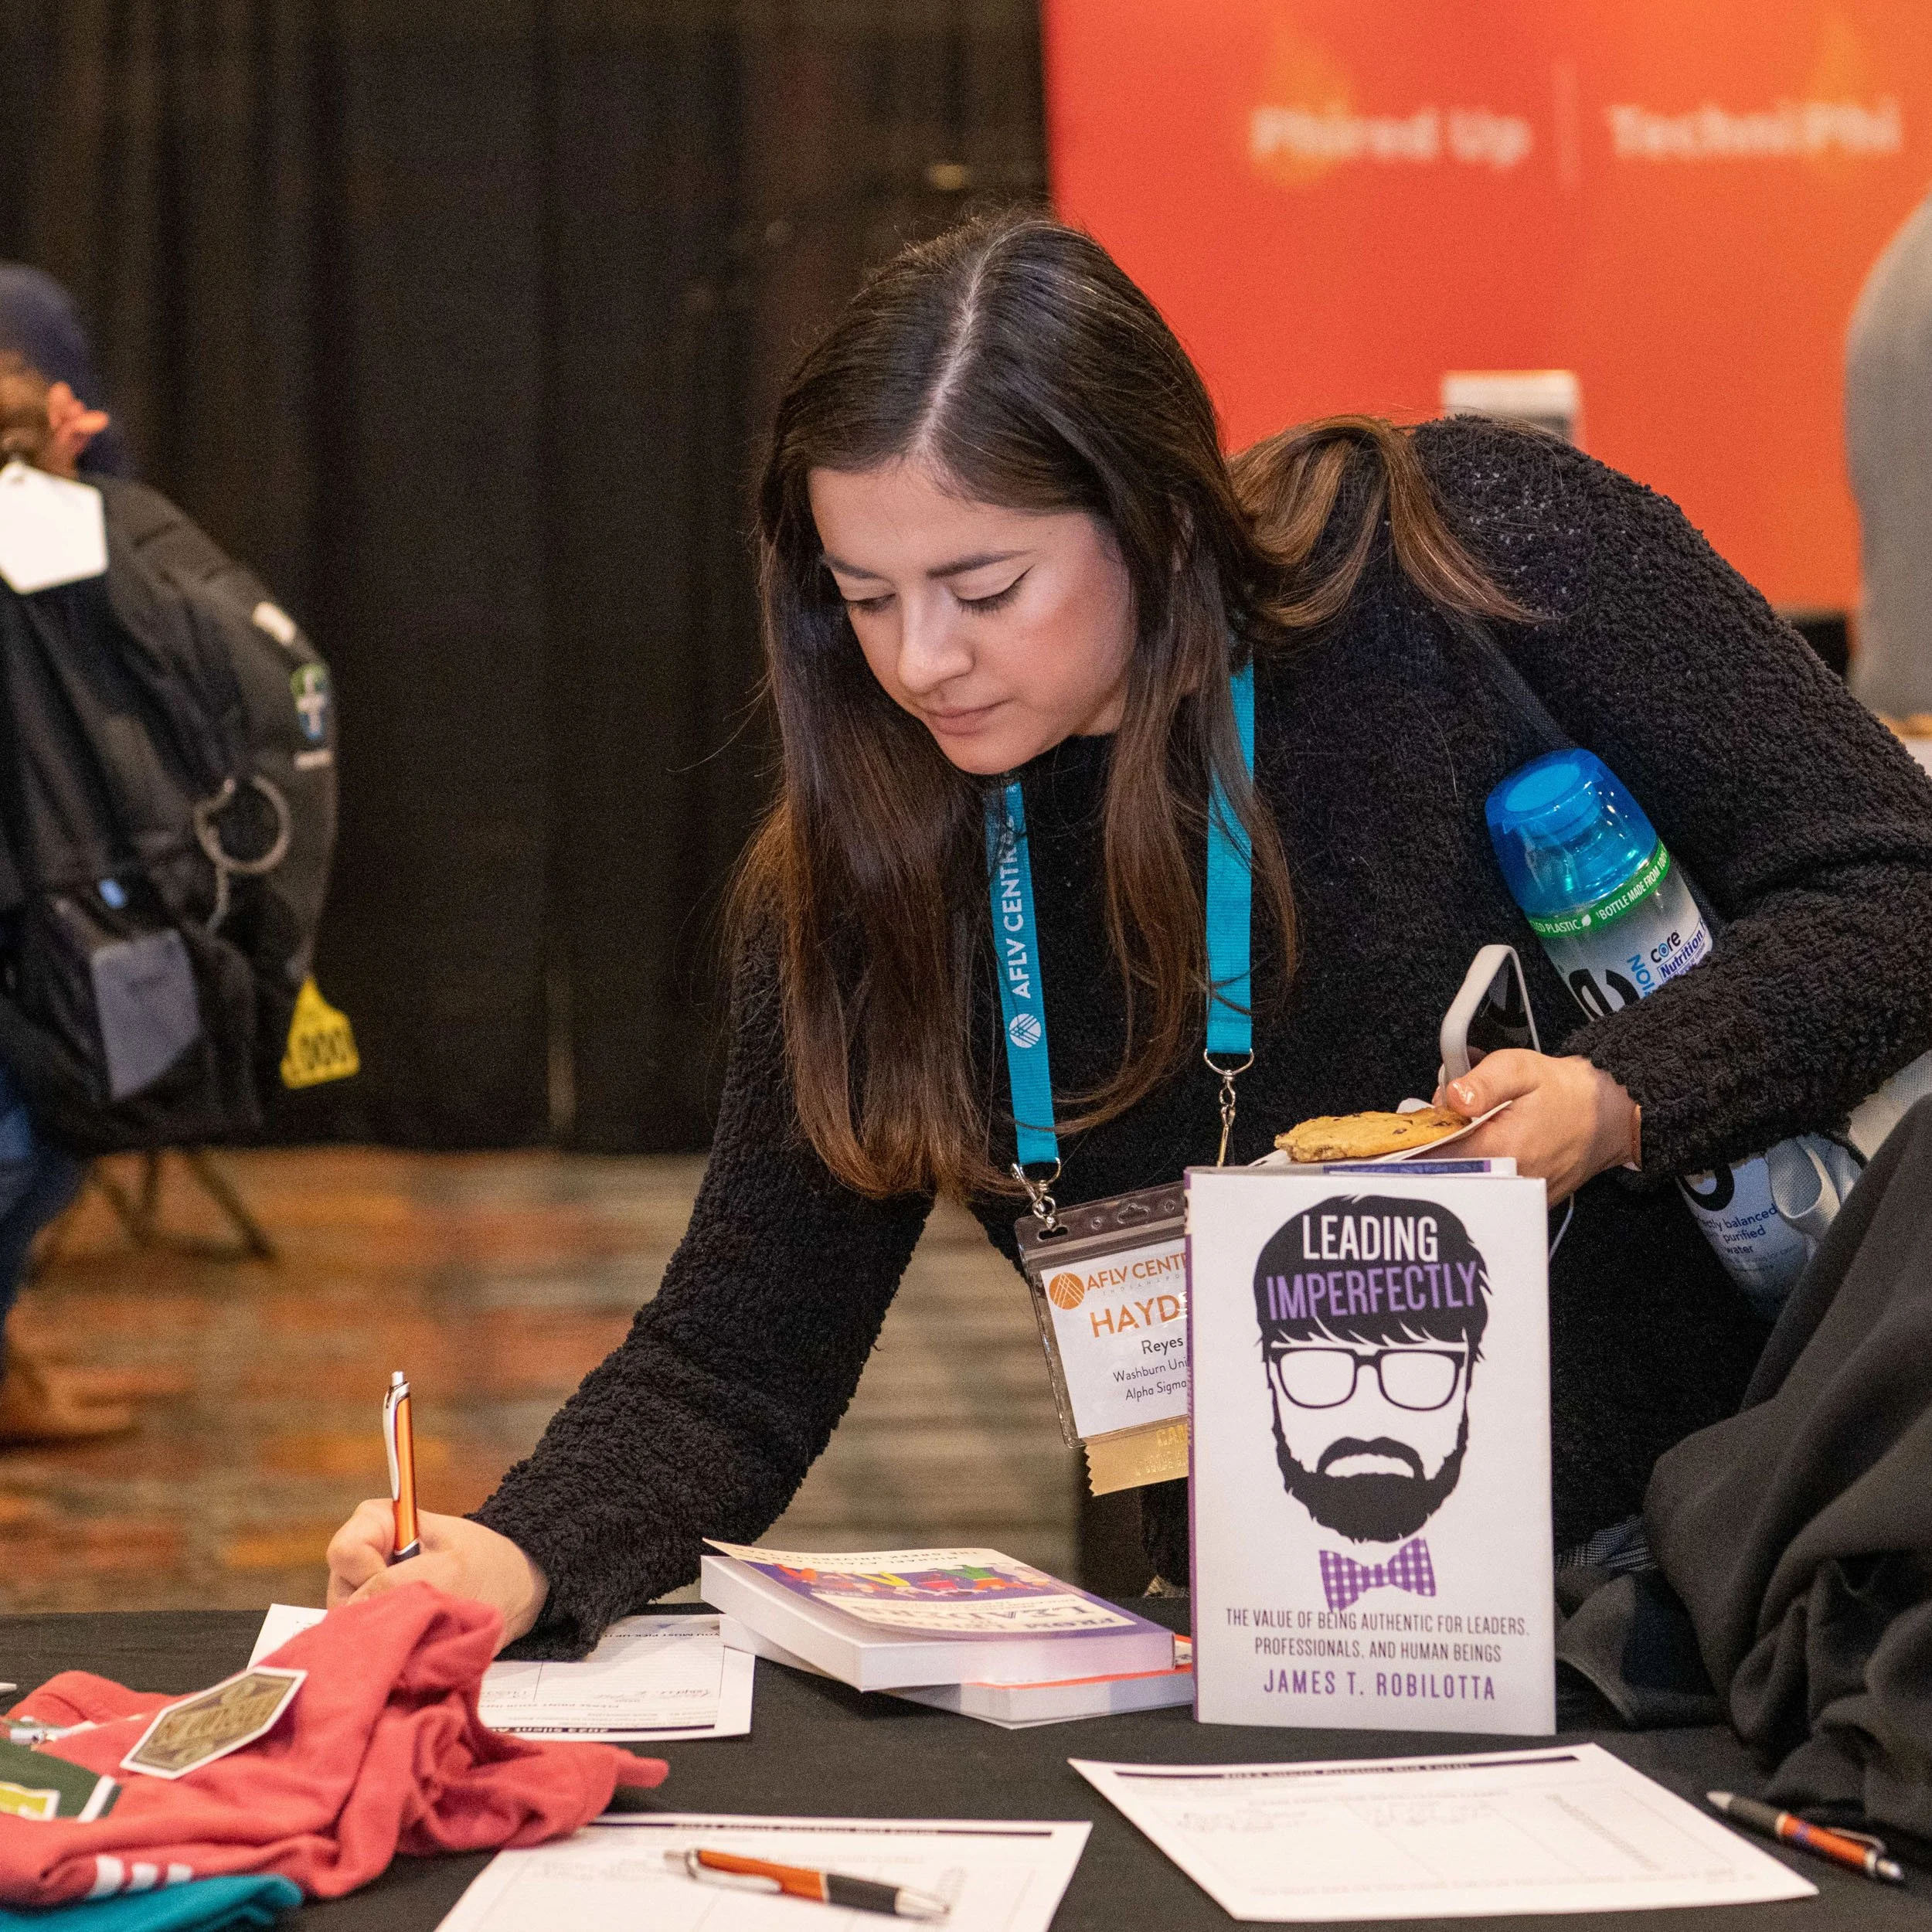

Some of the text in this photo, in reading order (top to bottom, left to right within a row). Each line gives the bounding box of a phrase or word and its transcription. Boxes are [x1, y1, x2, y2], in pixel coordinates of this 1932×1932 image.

[1627, 881, 1647, 903] MADE
[1643, 865, 1661, 889] FROM
[1545, 919, 1581, 934] PLASTIC
[1659, 930, 1703, 979] Nutrition
[1006, 938, 1032, 999] AFLV
[1722, 1202, 1778, 1229] balanced
[1301, 1214, 1439, 1263] LEADING
[1723, 1225, 1767, 1244] purified
[1726, 1245, 1754, 1255] water
[1087, 1265, 1128, 1291] AFLV
[1266, 1260, 1477, 1321] IMPERFECTLY
[1090, 1294, 1182, 1338] HAYD
[1141, 1337, 1184, 1355] Reyes
[1113, 1356, 1188, 1383] Washburn Uni
[1125, 1379, 1187, 1403] Alpha Sigma
[1226, 1608, 1250, 1627] THE
[1253, 1609, 1293, 1628] VALUE
[1298, 1611, 1315, 1630] OF
[1318, 1611, 1357, 1631] BEING
[1361, 1613, 1433, 1633] AUTHENTIC
[1437, 1614, 1463, 1634] FOR
[1369, 1639, 1396, 1660] AND
[1400, 1641, 1449, 1662] HUMAN
[1453, 1643, 1502, 1663] BEINGS
[1264, 1668, 1496, 1700] JAMES T. ROBILOTTA
